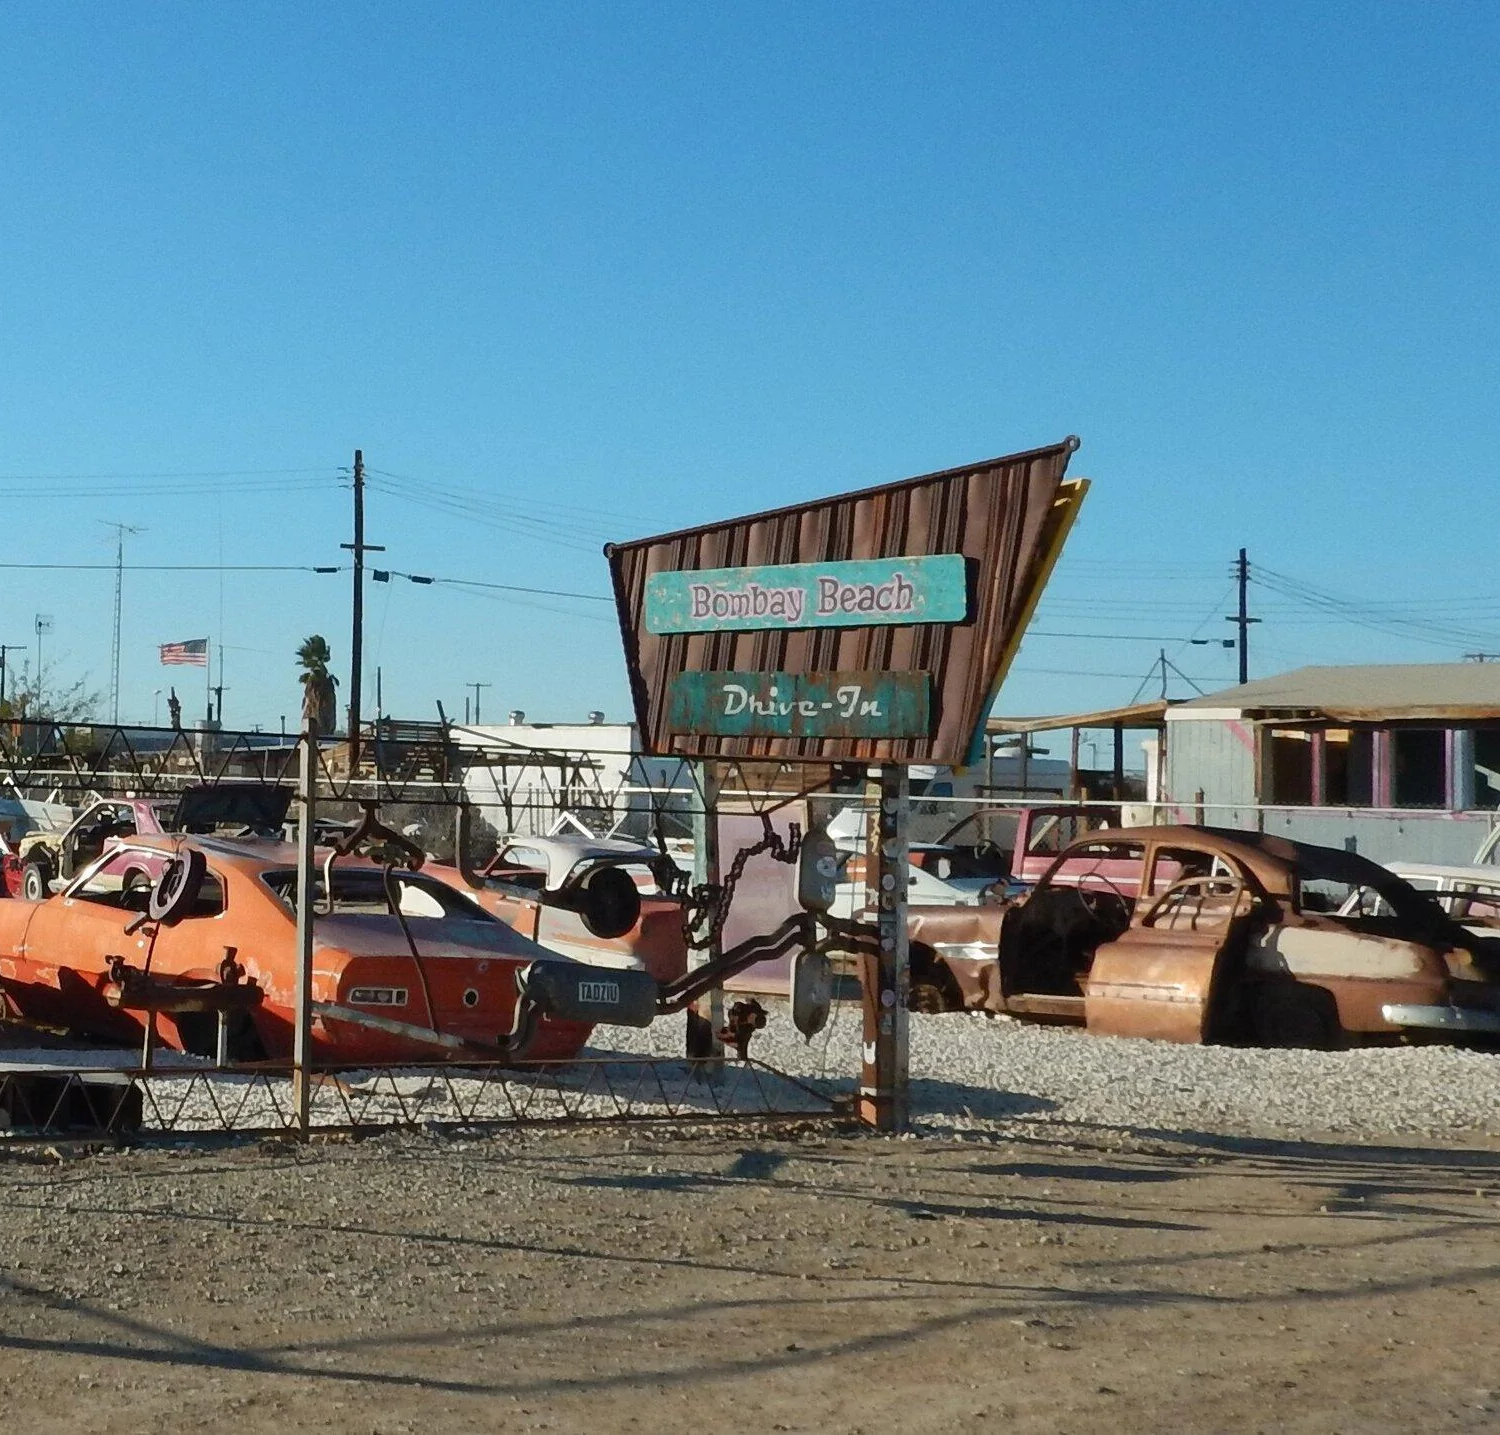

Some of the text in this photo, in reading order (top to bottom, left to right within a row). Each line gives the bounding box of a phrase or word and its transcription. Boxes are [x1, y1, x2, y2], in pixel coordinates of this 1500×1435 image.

[691, 573, 914, 622] Bombay Beach
[722, 684, 883, 718] Drive-In
